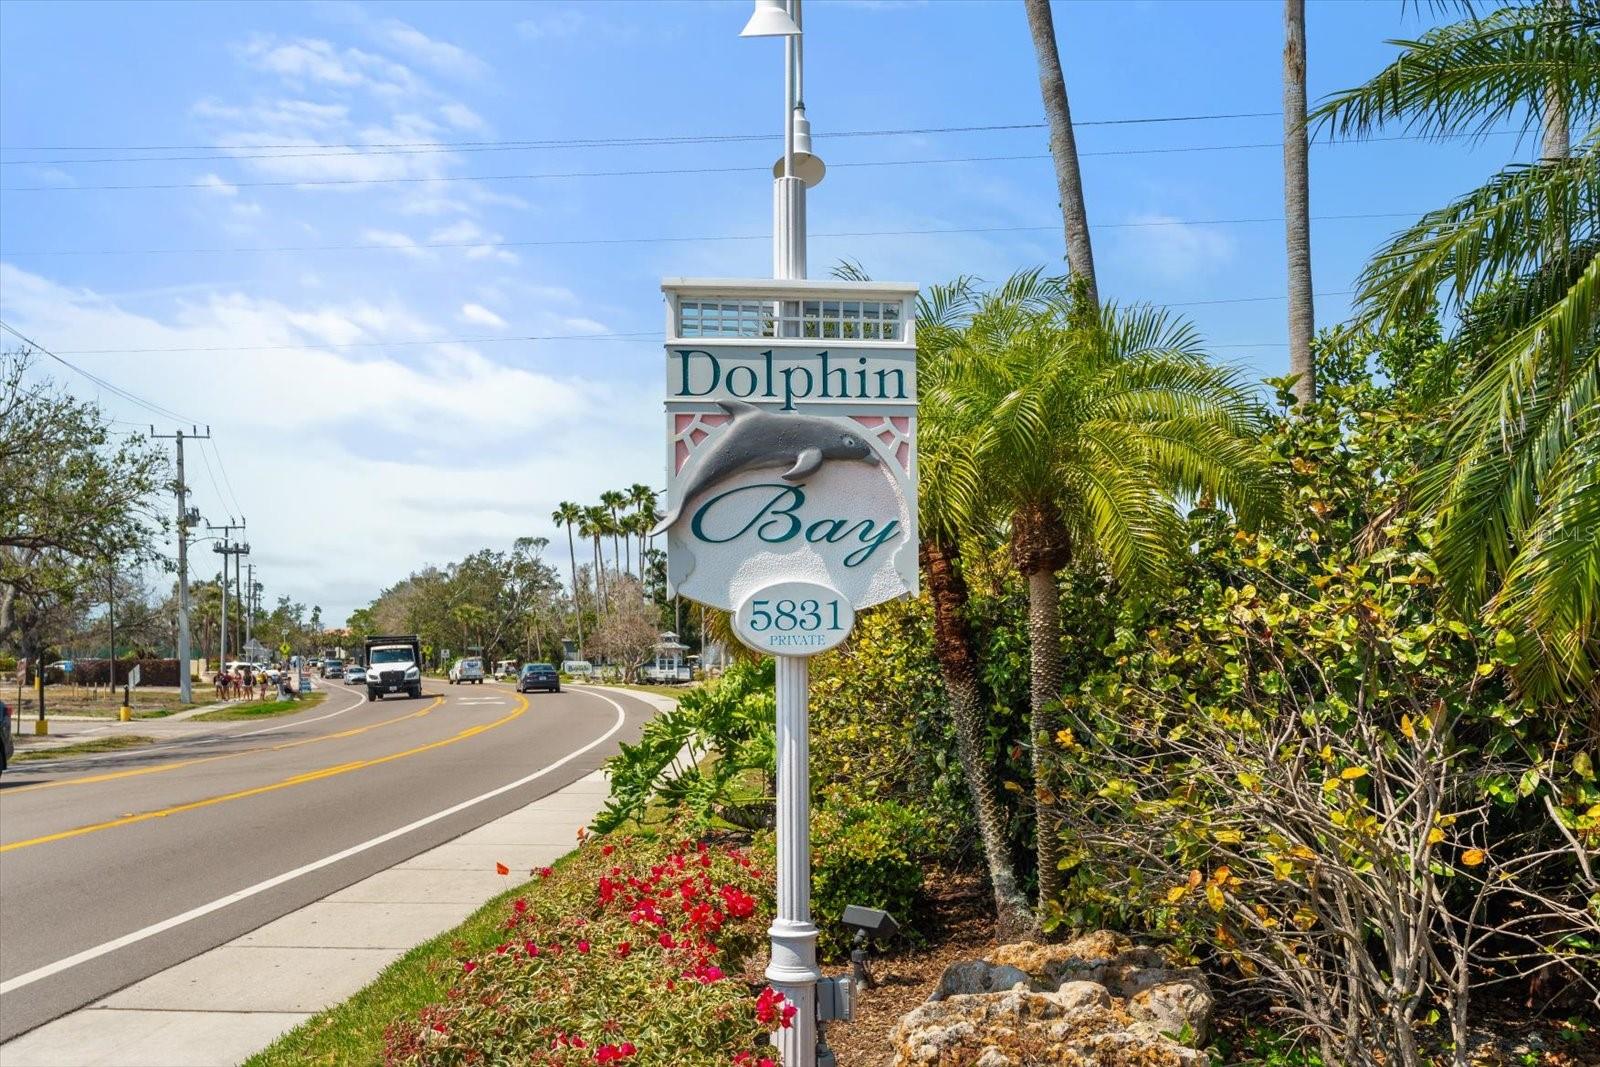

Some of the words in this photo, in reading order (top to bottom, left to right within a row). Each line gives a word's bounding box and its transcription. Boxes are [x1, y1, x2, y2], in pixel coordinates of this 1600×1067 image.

[674, 349, 908, 411] Dolphin
[690, 483, 900, 568] Bay
[750, 599, 844, 632] 5831
[769, 634, 826, 646] PRIVATE
